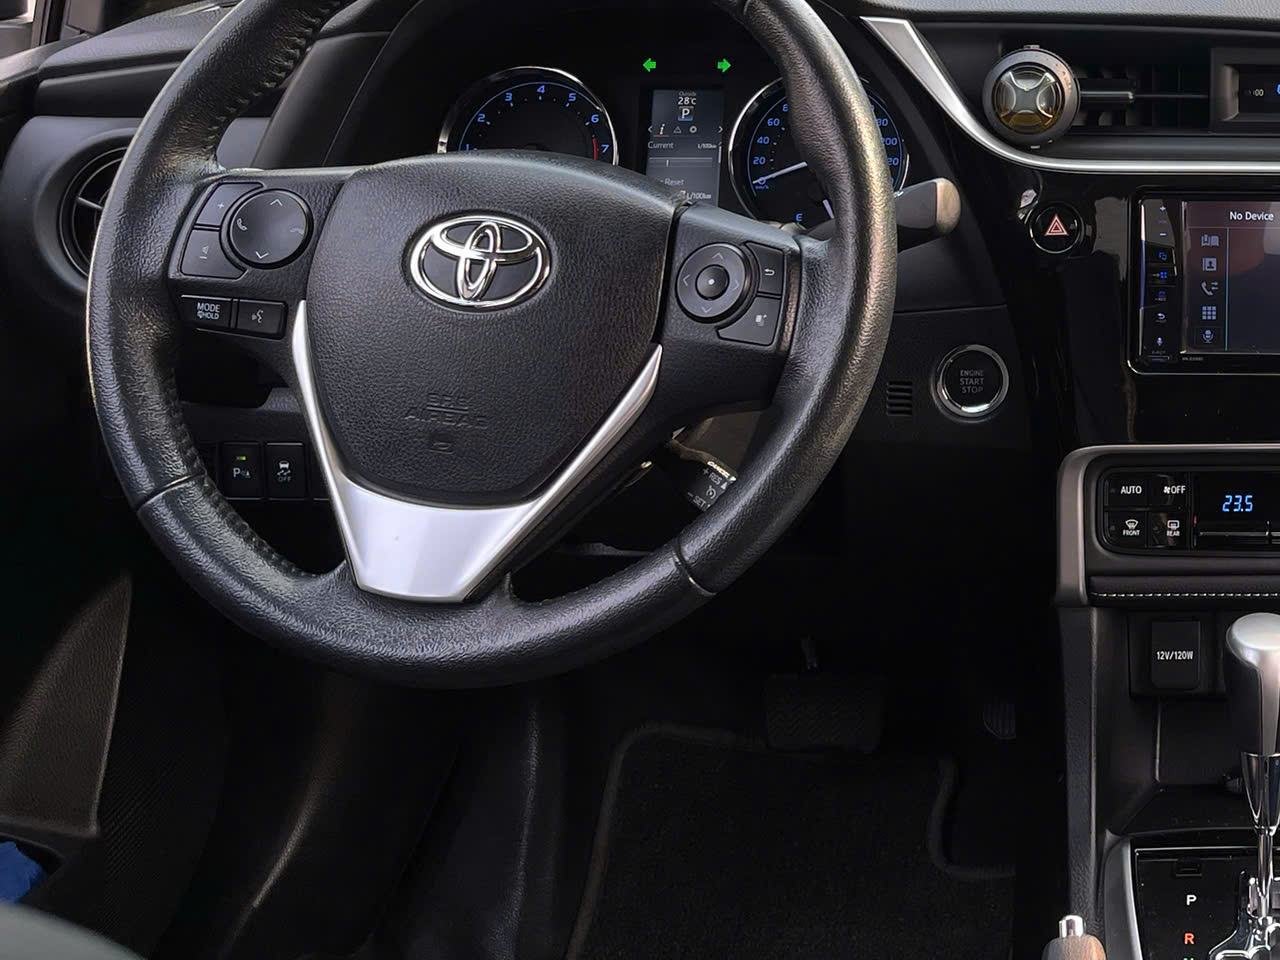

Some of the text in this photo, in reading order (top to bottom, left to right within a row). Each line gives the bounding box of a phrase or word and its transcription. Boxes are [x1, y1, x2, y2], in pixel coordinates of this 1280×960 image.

[536, 85, 546, 94] 4
[505, 92, 513, 102] 3
[568, 93, 577, 102] 5
[681, 108, 690, 119] P
[477, 114, 486, 123] 2
[590, 114, 599, 123] 6
[767, 118, 780, 127] 60
[647, 140, 674, 149] Current
[756, 136, 770, 145] 40
[601, 144, 610, 153] 7
[753, 156, 766, 165] 20
[664, 178, 685, 186] Reset
[795, 213, 803, 222] E
[1229, 211, 1275, 221] No Device
[196, 302, 221, 313] MODE
[960, 369, 985, 377] ENGINE
[959, 377, 985, 385] START
[961, 386, 984, 394] STOP
[708, 472, 723, 485] RES
[1120, 485, 1142, 496] AUTO
[1170, 484, 1186, 495] OFF
[1222, 495, 1254, 512] 23.5
[1122, 528, 1140, 537] FRONT
[1166, 528, 1180, 537] REAR
[1156, 650, 1194, 661] 12V/120W
[1186, 894, 1197, 906] P
[1184, 932, 1195, 945] R
